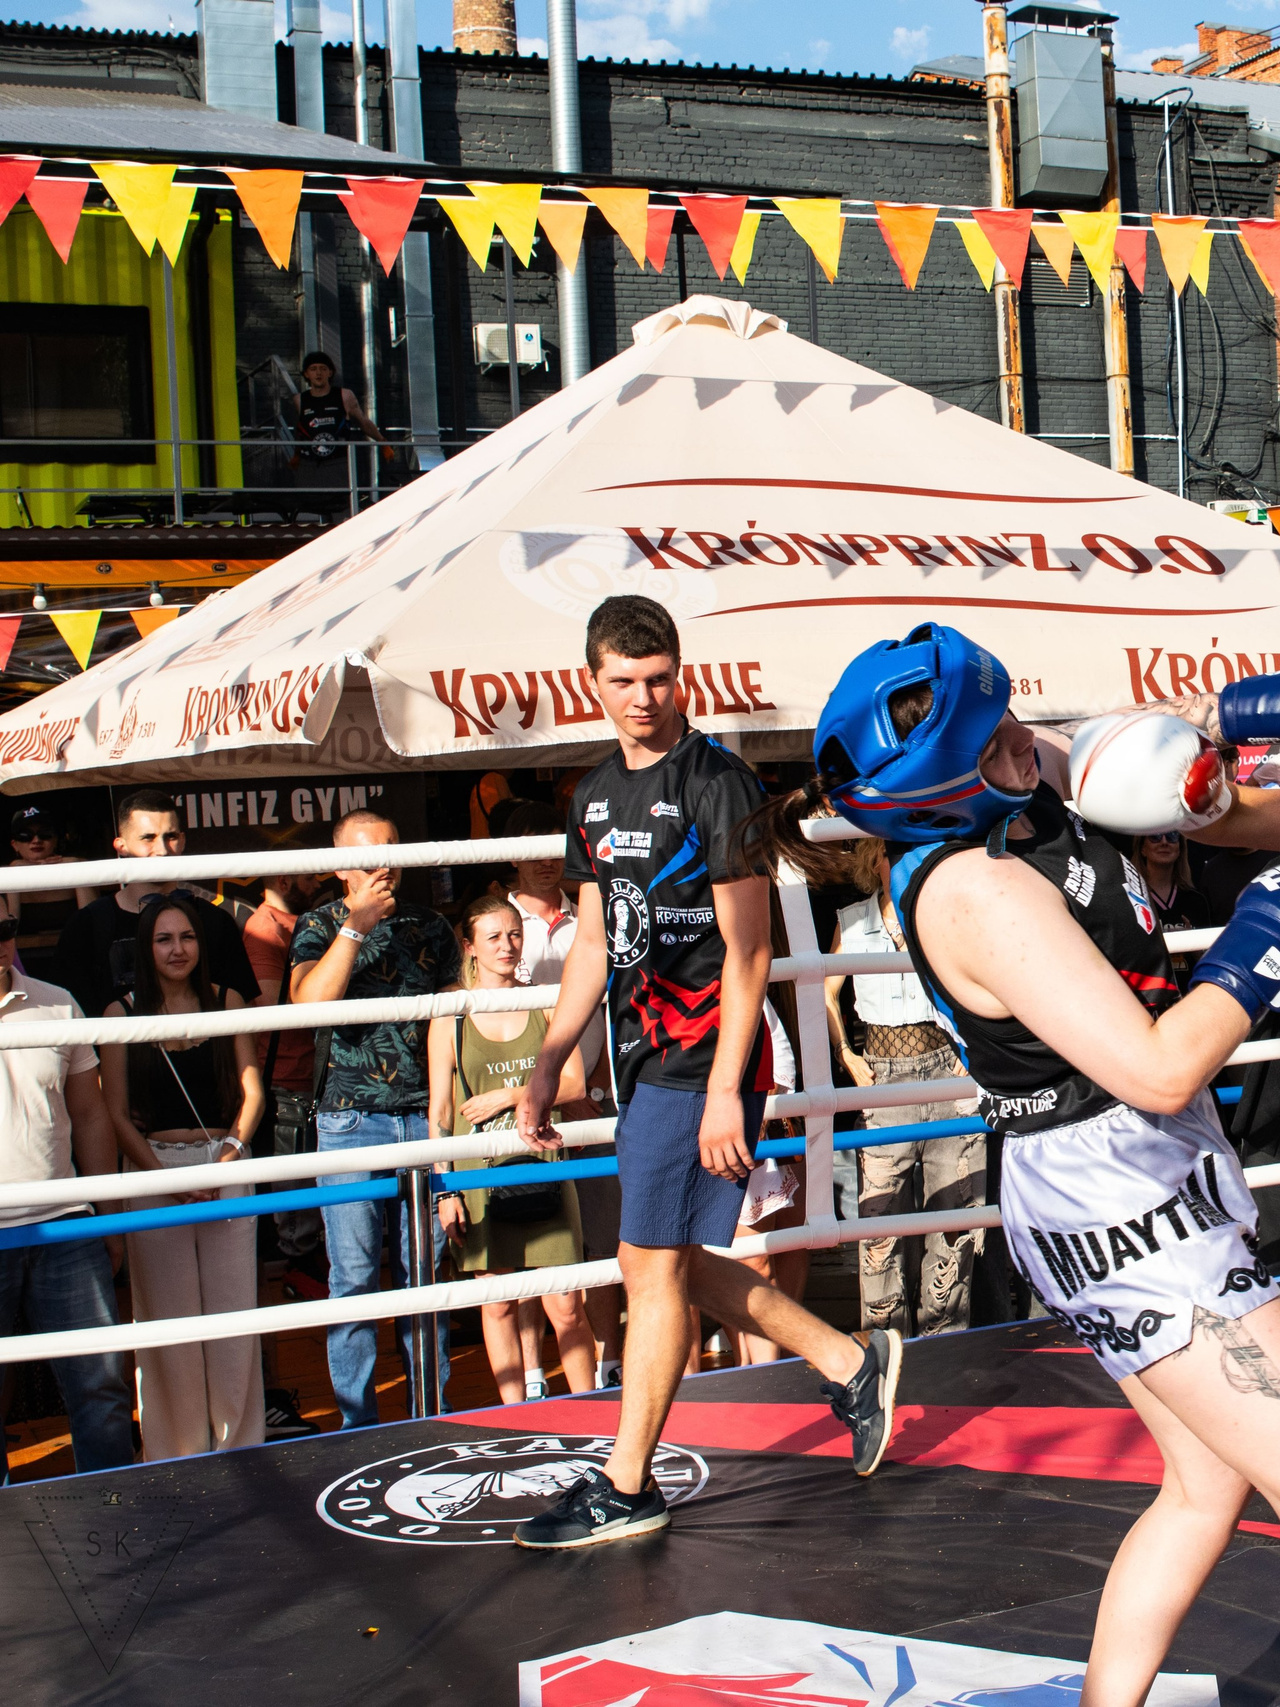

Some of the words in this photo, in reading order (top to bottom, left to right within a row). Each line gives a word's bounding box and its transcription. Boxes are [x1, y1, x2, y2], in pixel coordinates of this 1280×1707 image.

[429, 661, 777, 738] КРУШИЦЕ
[655, 911, 715, 924] КРУТОЯР
[503, 1076, 522, 1088] MY
